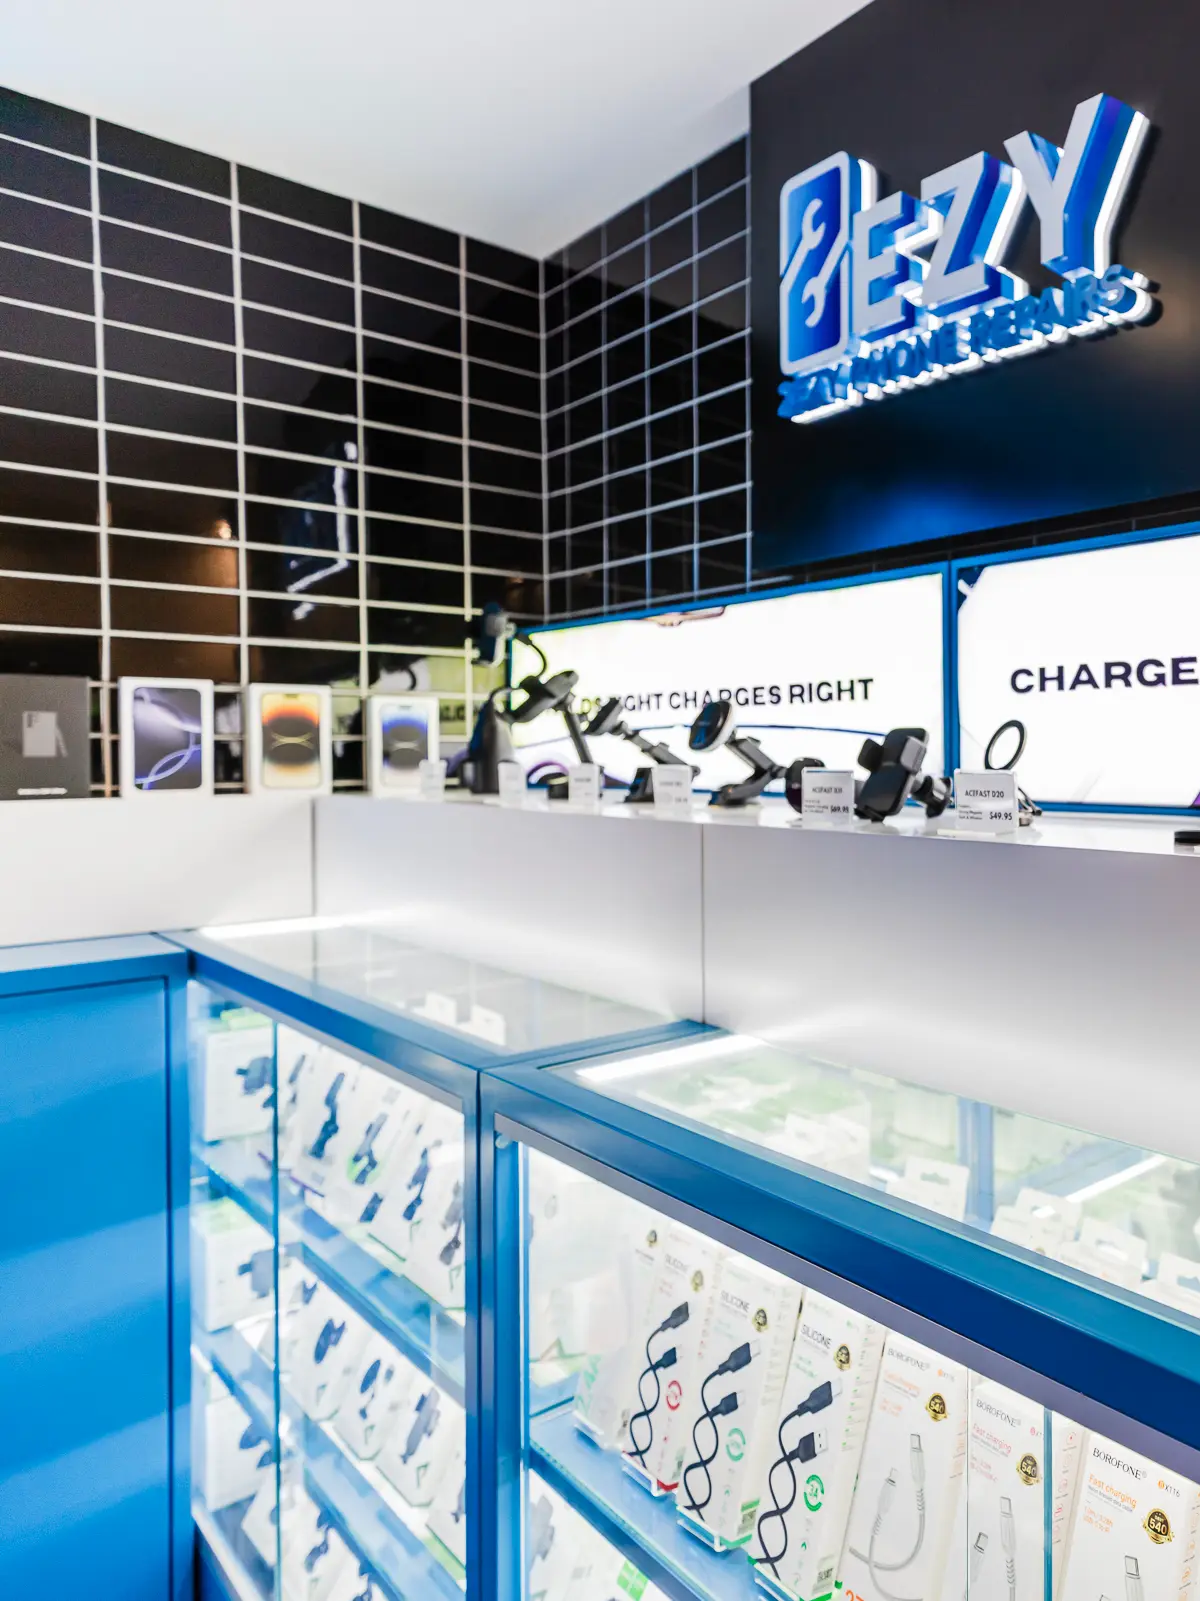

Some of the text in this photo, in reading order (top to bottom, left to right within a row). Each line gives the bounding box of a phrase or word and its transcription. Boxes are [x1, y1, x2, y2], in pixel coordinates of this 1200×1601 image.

[851, 93, 1140, 337] EZY
[969, 264, 1148, 352] REPAIRS
[1010, 656, 1200, 694] CHARGE
[788, 678, 874, 705] RIGHT
[965, 789, 991, 799] ACEFAST
[989, 811, 1013, 821] $49.95
[801, 1323, 832, 1350] SILICONE
[976, 1399, 1017, 1428] BOROFONE
[1092, 1447, 1142, 1480] BOROFONE
[1089, 1474, 1137, 1510] Fast charging
[1149, 1519, 1167, 1535] 540
